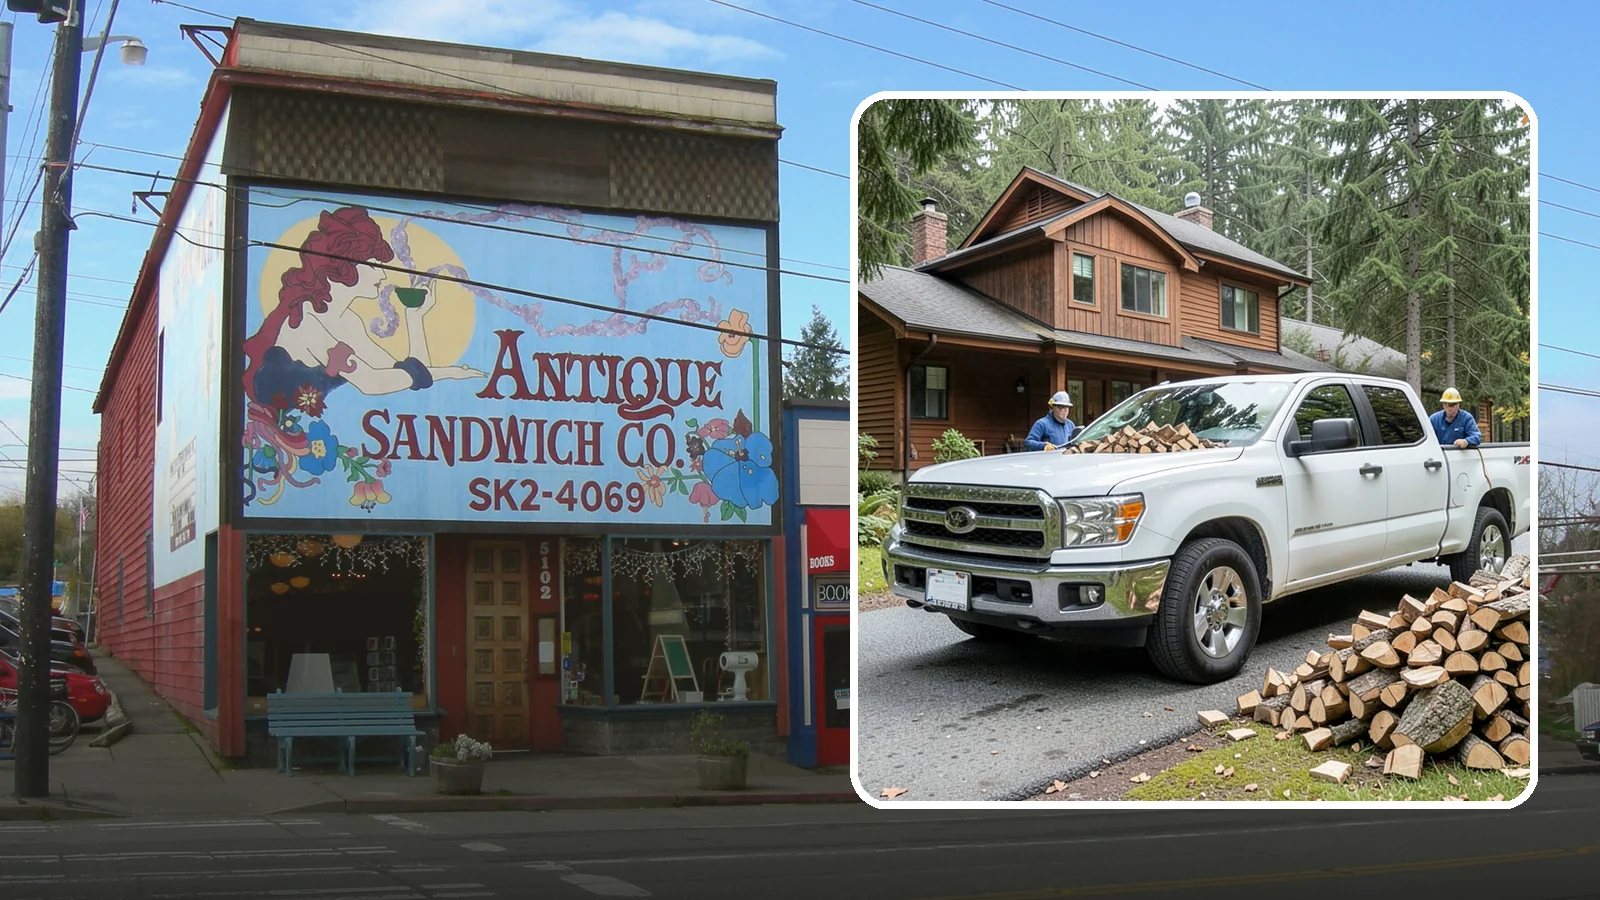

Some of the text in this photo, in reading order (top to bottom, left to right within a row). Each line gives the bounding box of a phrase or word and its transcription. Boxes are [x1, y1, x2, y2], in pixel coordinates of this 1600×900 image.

[476, 329, 724, 420] ANTIQUE
[361, 408, 684, 469] SANDWICH CO.
[468, 476, 645, 513] SK2-4069
[540, 541, 551, 600] 5102
[809, 555, 834, 568] BOOKS
